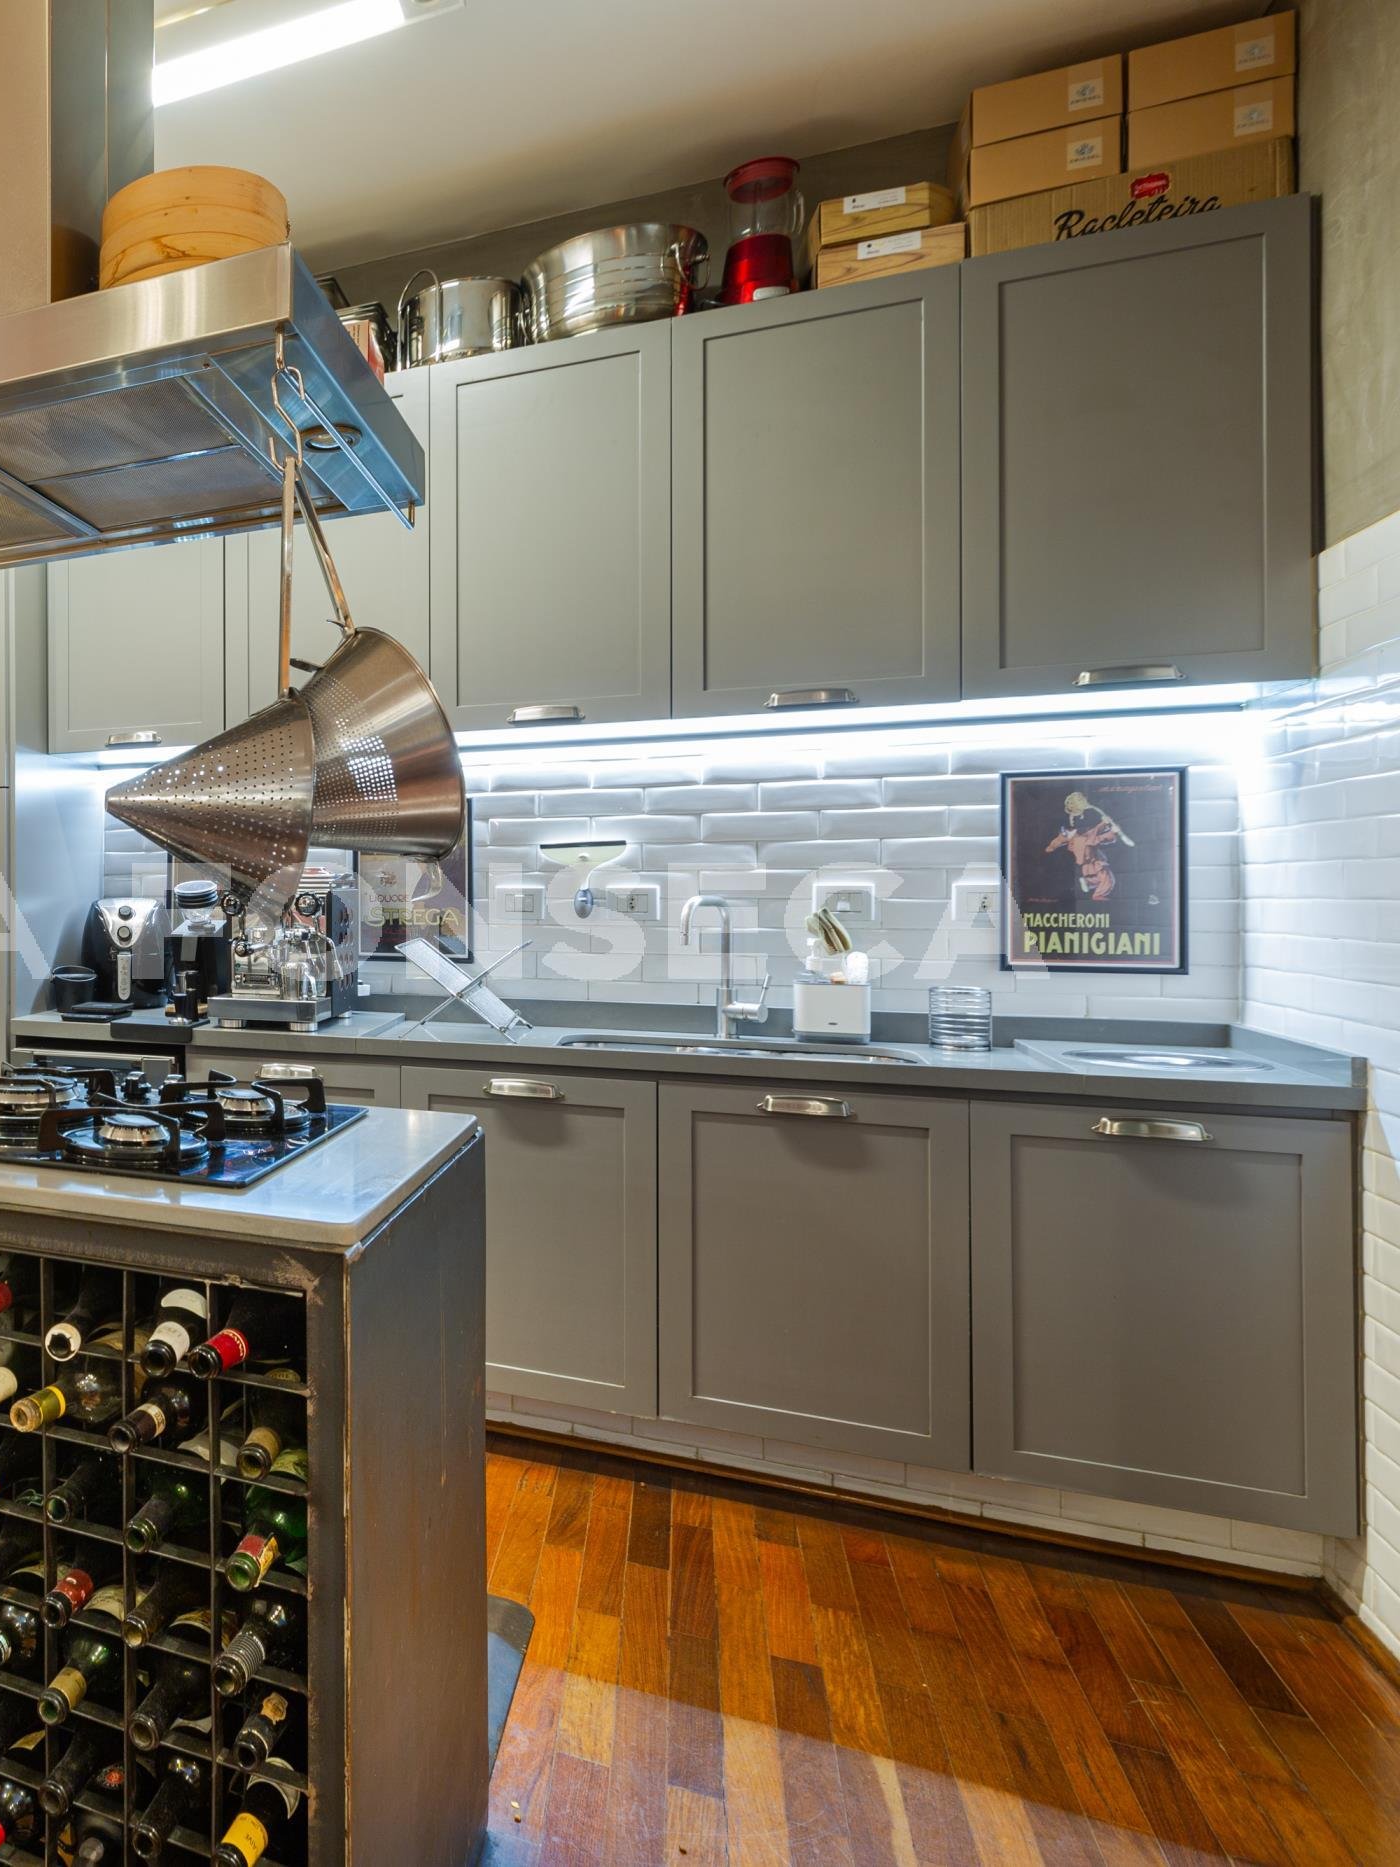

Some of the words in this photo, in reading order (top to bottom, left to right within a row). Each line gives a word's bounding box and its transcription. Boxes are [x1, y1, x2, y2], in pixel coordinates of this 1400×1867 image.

[1053, 194, 1223, 242] Racleteira
[364, 907, 459, 927] STREGA
[1023, 912, 1110, 929] MACCHERONI
[1023, 931, 1161, 955] PIANIGIANI
